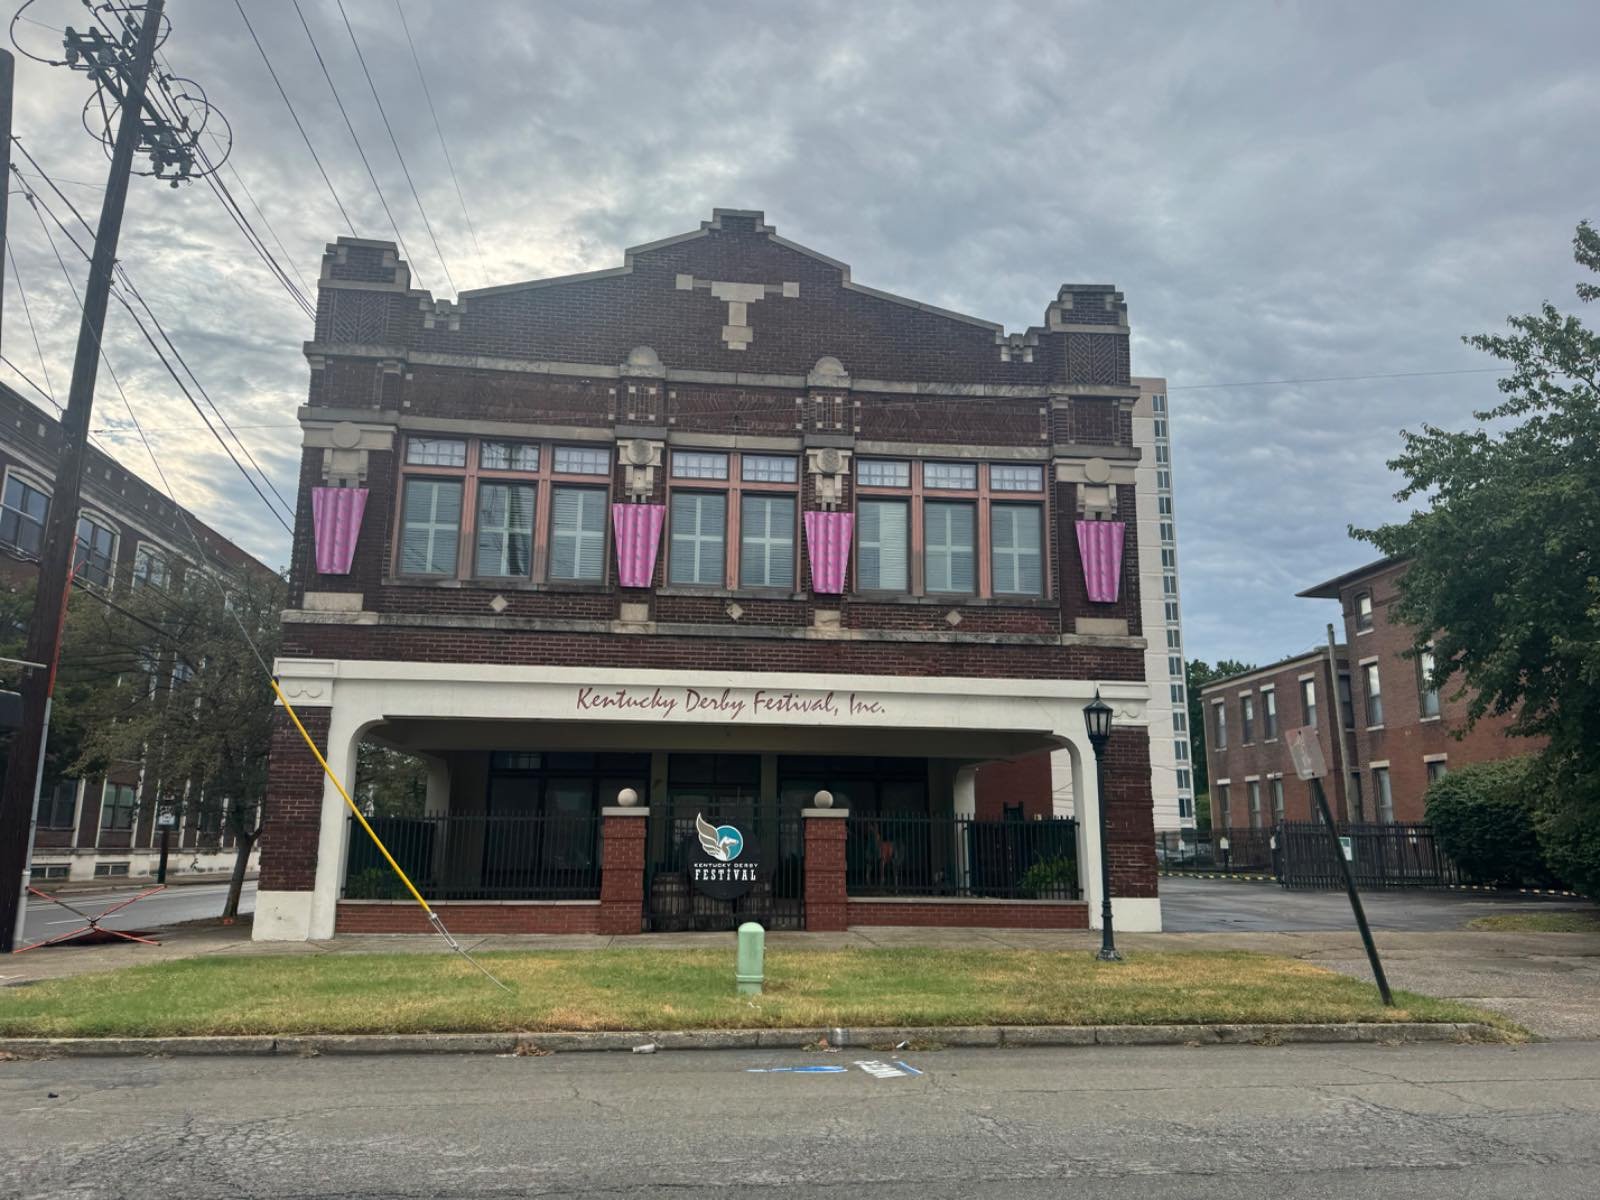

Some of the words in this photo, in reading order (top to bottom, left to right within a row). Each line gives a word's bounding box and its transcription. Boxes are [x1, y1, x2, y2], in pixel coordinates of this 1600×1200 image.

[576, 687, 677, 718] Kentucky
[686, 688, 745, 720] Derby
[753, 690, 838, 716] Festival,
[850, 693, 886, 715] Inc.
[695, 869, 756, 880] FESTIVAL
